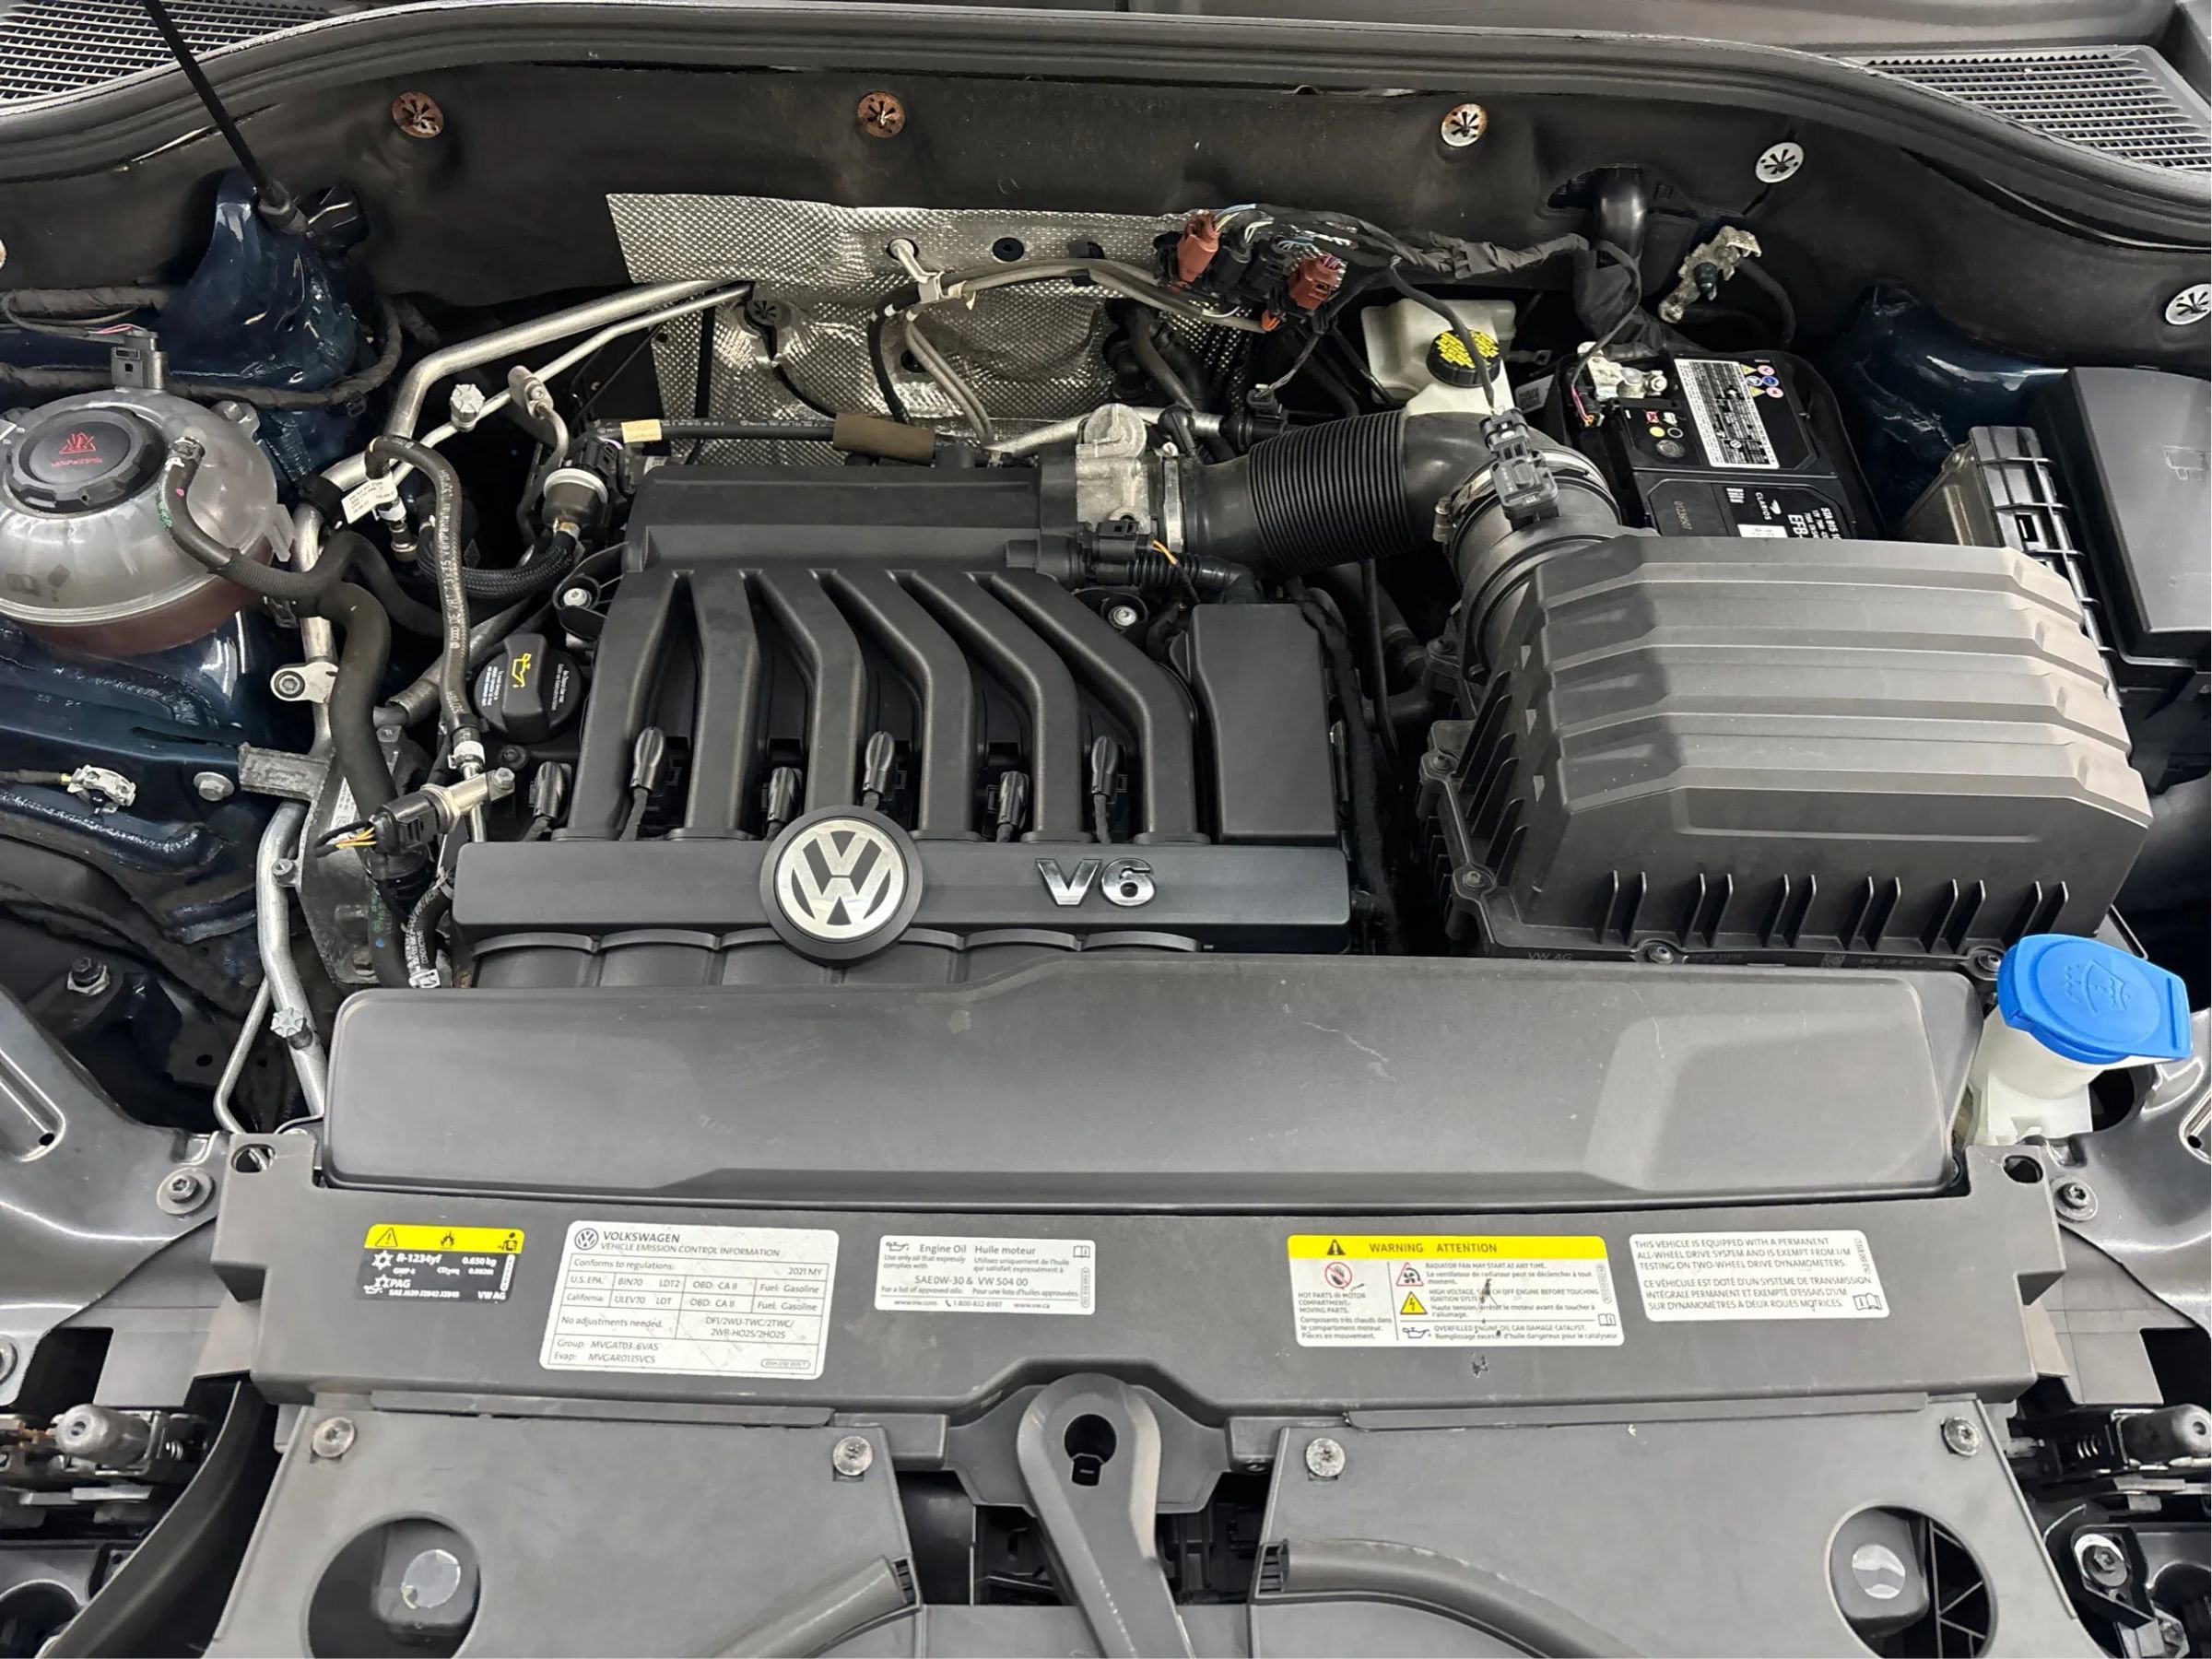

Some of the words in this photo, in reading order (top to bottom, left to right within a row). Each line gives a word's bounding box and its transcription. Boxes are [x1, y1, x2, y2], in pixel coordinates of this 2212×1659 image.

[1755, 491, 1772, 521] CLARIOS
[1035, 857, 1158, 908] V6
[603, 1230, 681, 1243] VOLKSWAGEN
[920, 1243, 951, 1254] Engine
[953, 1244, 967, 1253] Oil
[1369, 1243, 1424, 1253] WARNING
[1436, 1242, 1498, 1253] ATTENTION
[1634, 1241, 1654, 1249] THIS
[1655, 1240, 1689, 1248] VEHICLE
[1701, 1239, 1744, 1249] EQUIPPED
[1778, 1237, 1829, 1246] PERMANENT
[601, 1242, 634, 1252] VEHICLE
[636, 1243, 677, 1253] EMISSION
[678, 1245, 718, 1255] CONTROL
[720, 1247, 780, 1257] INFORMATION
[974, 1245, 999, 1254] Huile
[1002, 1247, 1036, 1255] moteur
[1638, 1251, 1685, 1260] ALL-WHEEL
[1686, 1250, 1712, 1258] DRIVE
[1712, 1249, 1743, 1258] SYSTEM
[1747, 1249, 1765, 1257] AND
[1811, 1248, 1835, 1256] FROM
[1837, 1248, 1851, 1256] I/M
[396, 1253, 442, 1265] R-1234yf
[486, 1257, 497, 1267] kg
[574, 1258, 614, 1267] Conforms
[1640, 1262, 1676, 1270] TESTING
[1677, 1261, 1690, 1270] ON
[1692, 1260, 1746, 1269] TWO-WHEEL
[1747, 1260, 1772, 1268] DRIVE
[1774, 1259, 1846, 1267] DYNAMOMETERS.
[788, 1267, 806, 1276] 2021
[807, 1267, 823, 1277] MY
[389, 1278, 411, 1288] PAG
[571, 1276, 585, 1284] U.S.
[618, 1277, 643, 1287] BIN70
[659, 1278, 680, 1288] LDT2
[718, 1281, 730, 1290] CA
[978, 1277, 994, 1286] VW
[996, 1277, 1014, 1286] 504
[1016, 1277, 1029, 1286] 00
[1643, 1280, 1654, 1288] CE
[1655, 1278, 1696, 1288] VÉHICULE
[1698, 1279, 1712, 1288] EST
[1738, 1277, 1759, 1287] D'UN
[1761, 1276, 1795, 1286] SYSTÈME
[1810, 1276, 1872, 1285] TRANSMISSION
[783, 1284, 819, 1294] Gasoline
[918, 1287, 949, 1295] approved
[1646, 1290, 1690, 1300] INTÉGRALE
[1691, 1289, 1741, 1299] PERMANENT
[1753, 1288, 1791, 1298] EXEMPTÉ
[1792, 1288, 1825, 1297] D'ESSAIS
[477, 1291, 493, 1300] VW
[493, 1291, 506, 1300] AG
[614, 1295, 646, 1304] ULEV70
[715, 1299, 727, 1308] CA
[781, 1301, 818, 1312] Gasoline
[1648, 1301, 1666, 1311] SUR
[1667, 1300, 1736, 1310] DYNAMOMÈTRES
[1745, 1300, 1769, 1309] DEUX
[1770, 1300, 1799, 1308] ROUES
[1800, 1300, 1843, 1308] MOTRICES.
[561, 1316, 574, 1324] No
[575, 1316, 628, 1327] adjustments
[629, 1319, 664, 1328] needed.
